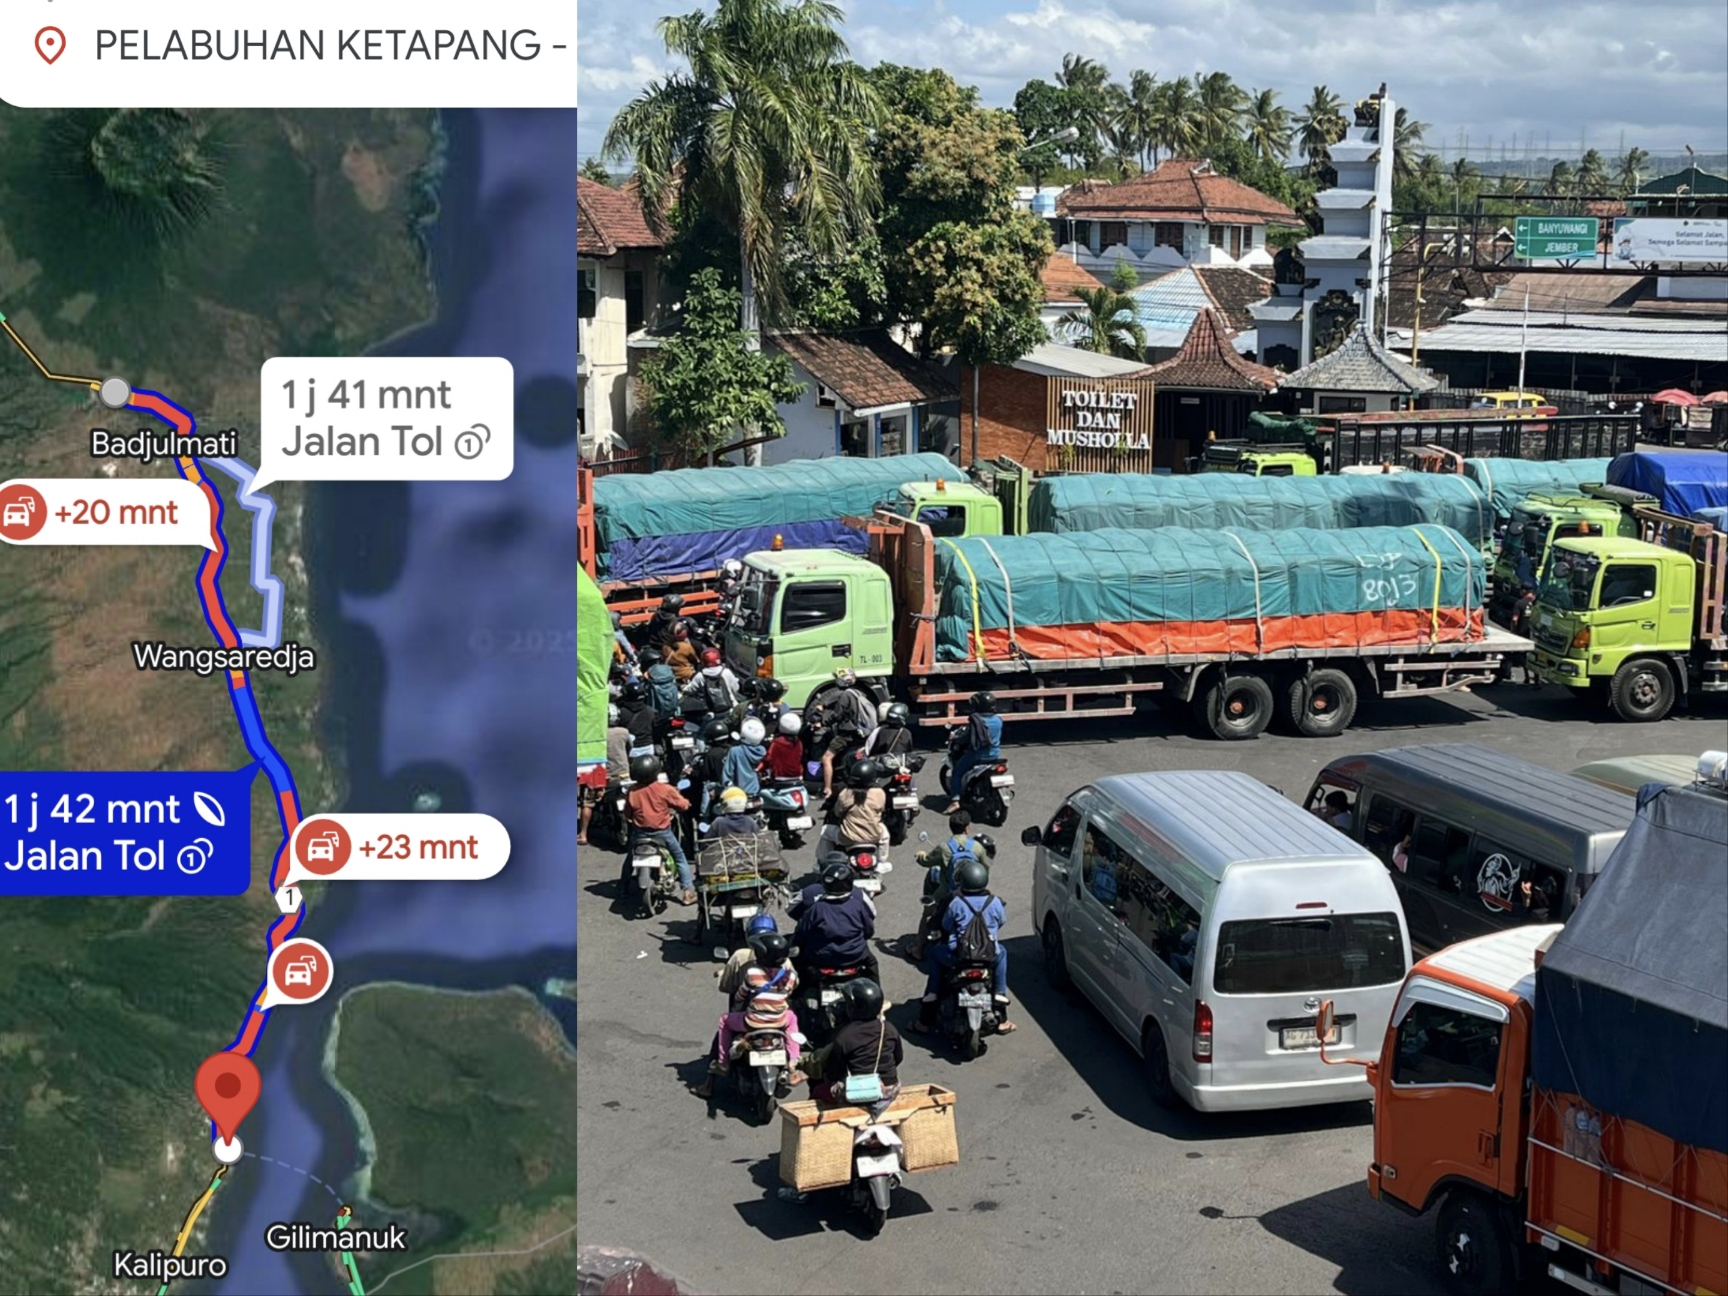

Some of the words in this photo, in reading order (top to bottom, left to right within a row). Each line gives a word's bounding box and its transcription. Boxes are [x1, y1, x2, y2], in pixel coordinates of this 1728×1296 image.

[95, 29, 324, 61] PELABUHAN
[338, 28, 541, 61] KETAPANG
[1538, 221, 1588, 235] BANYUWANGI
[1544, 242, 1579, 254] JEMBER
[282, 379, 295, 409] 1
[305, 378, 316, 418] j
[327, 379, 365, 409] 41
[378, 380, 452, 409] mnt
[1062, 390, 1137, 409] TOILET
[1077, 411, 1121, 428] DAN
[92, 431, 236, 462] Badjulmati
[281, 426, 380, 457] Jalan
[391, 426, 442, 457] Tol
[1047, 429, 1150, 449] MUSHOLLA
[55, 500, 111, 525] +20
[119, 500, 178, 525] mnt
[134, 643, 315, 674] Wangsaredja
[4, 793, 18, 824] 1
[27, 791, 39, 833] j
[50, 793, 96, 824] 42
[107, 794, 181, 824] mnt
[3, 839, 102, 871] Jalan
[113, 839, 165, 871] Tol
[359, 834, 411, 860] +23
[420, 835, 479, 860] mnt
[285, 888, 293, 906] 1
[266, 1224, 407, 1249] Gilimanuk
[114, 1251, 227, 1283] Kalipuro
